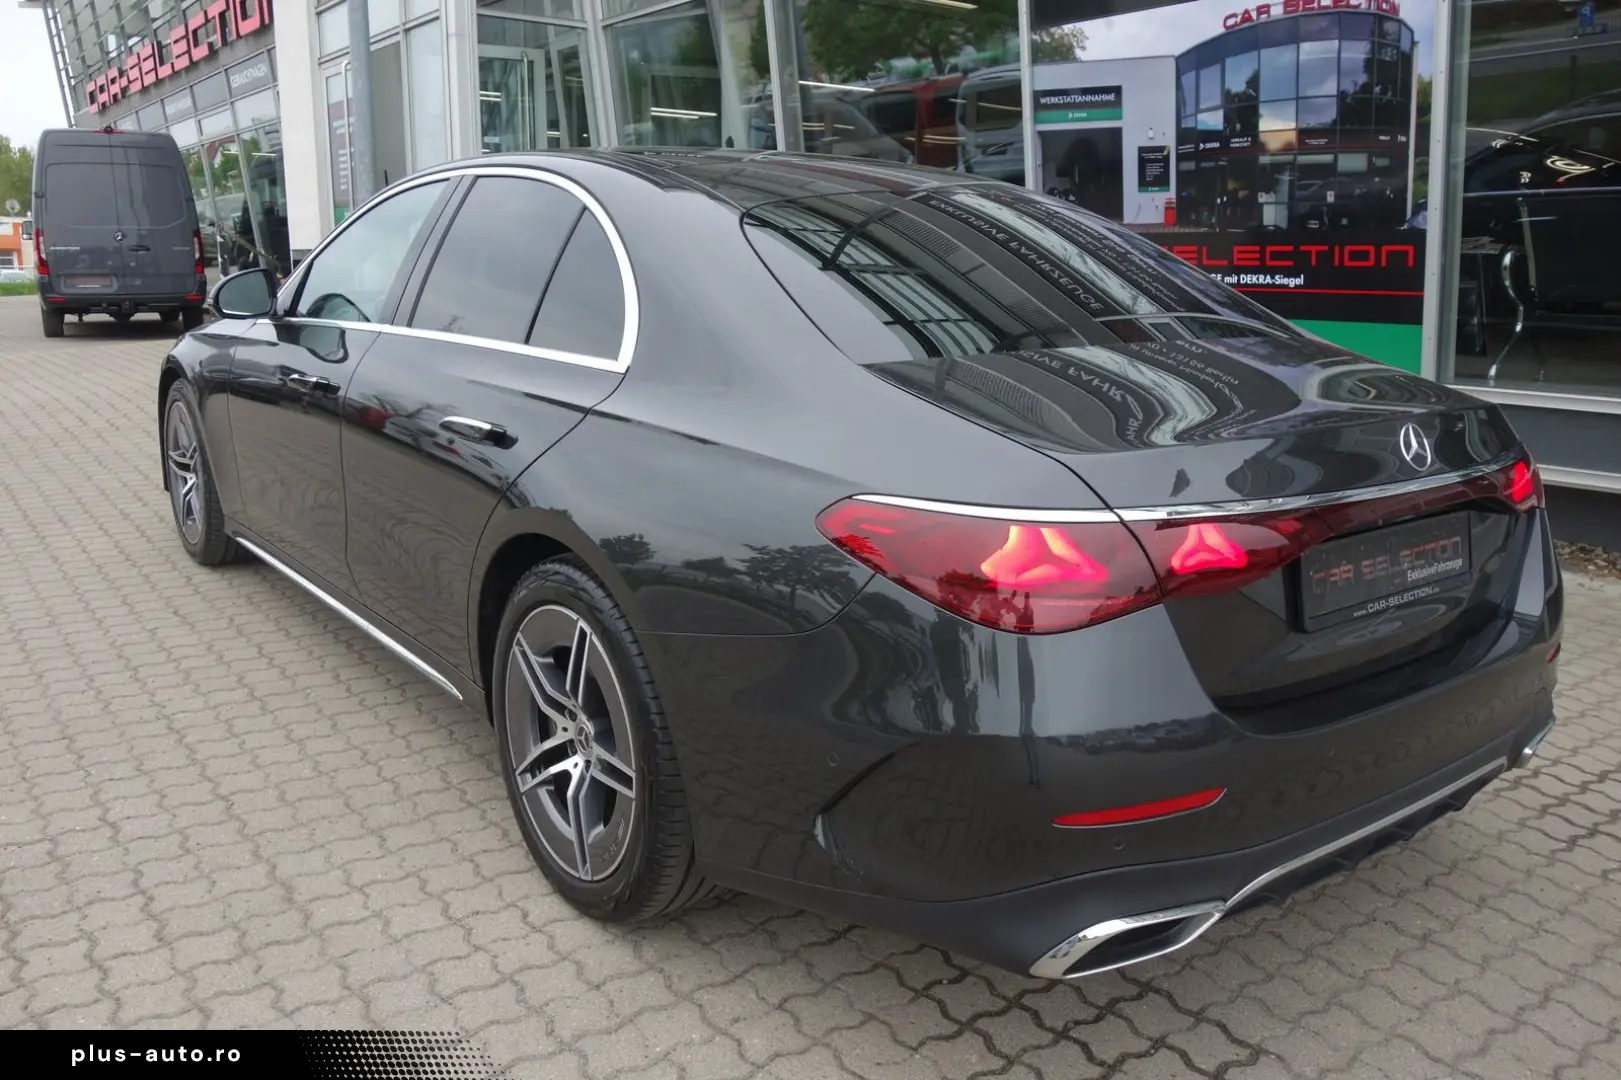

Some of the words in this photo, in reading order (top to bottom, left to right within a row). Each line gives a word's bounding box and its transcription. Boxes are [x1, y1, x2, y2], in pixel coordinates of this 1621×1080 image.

[1223, 8, 1270, 31] CAR
[1040, 93, 1116, 104] WERKSTATTANNAHME
[1160, 245, 1414, 267] ELECTION
[1224, 274, 1238, 284] mit
[1240, 274, 1304, 287] DEKRA-Siegel
